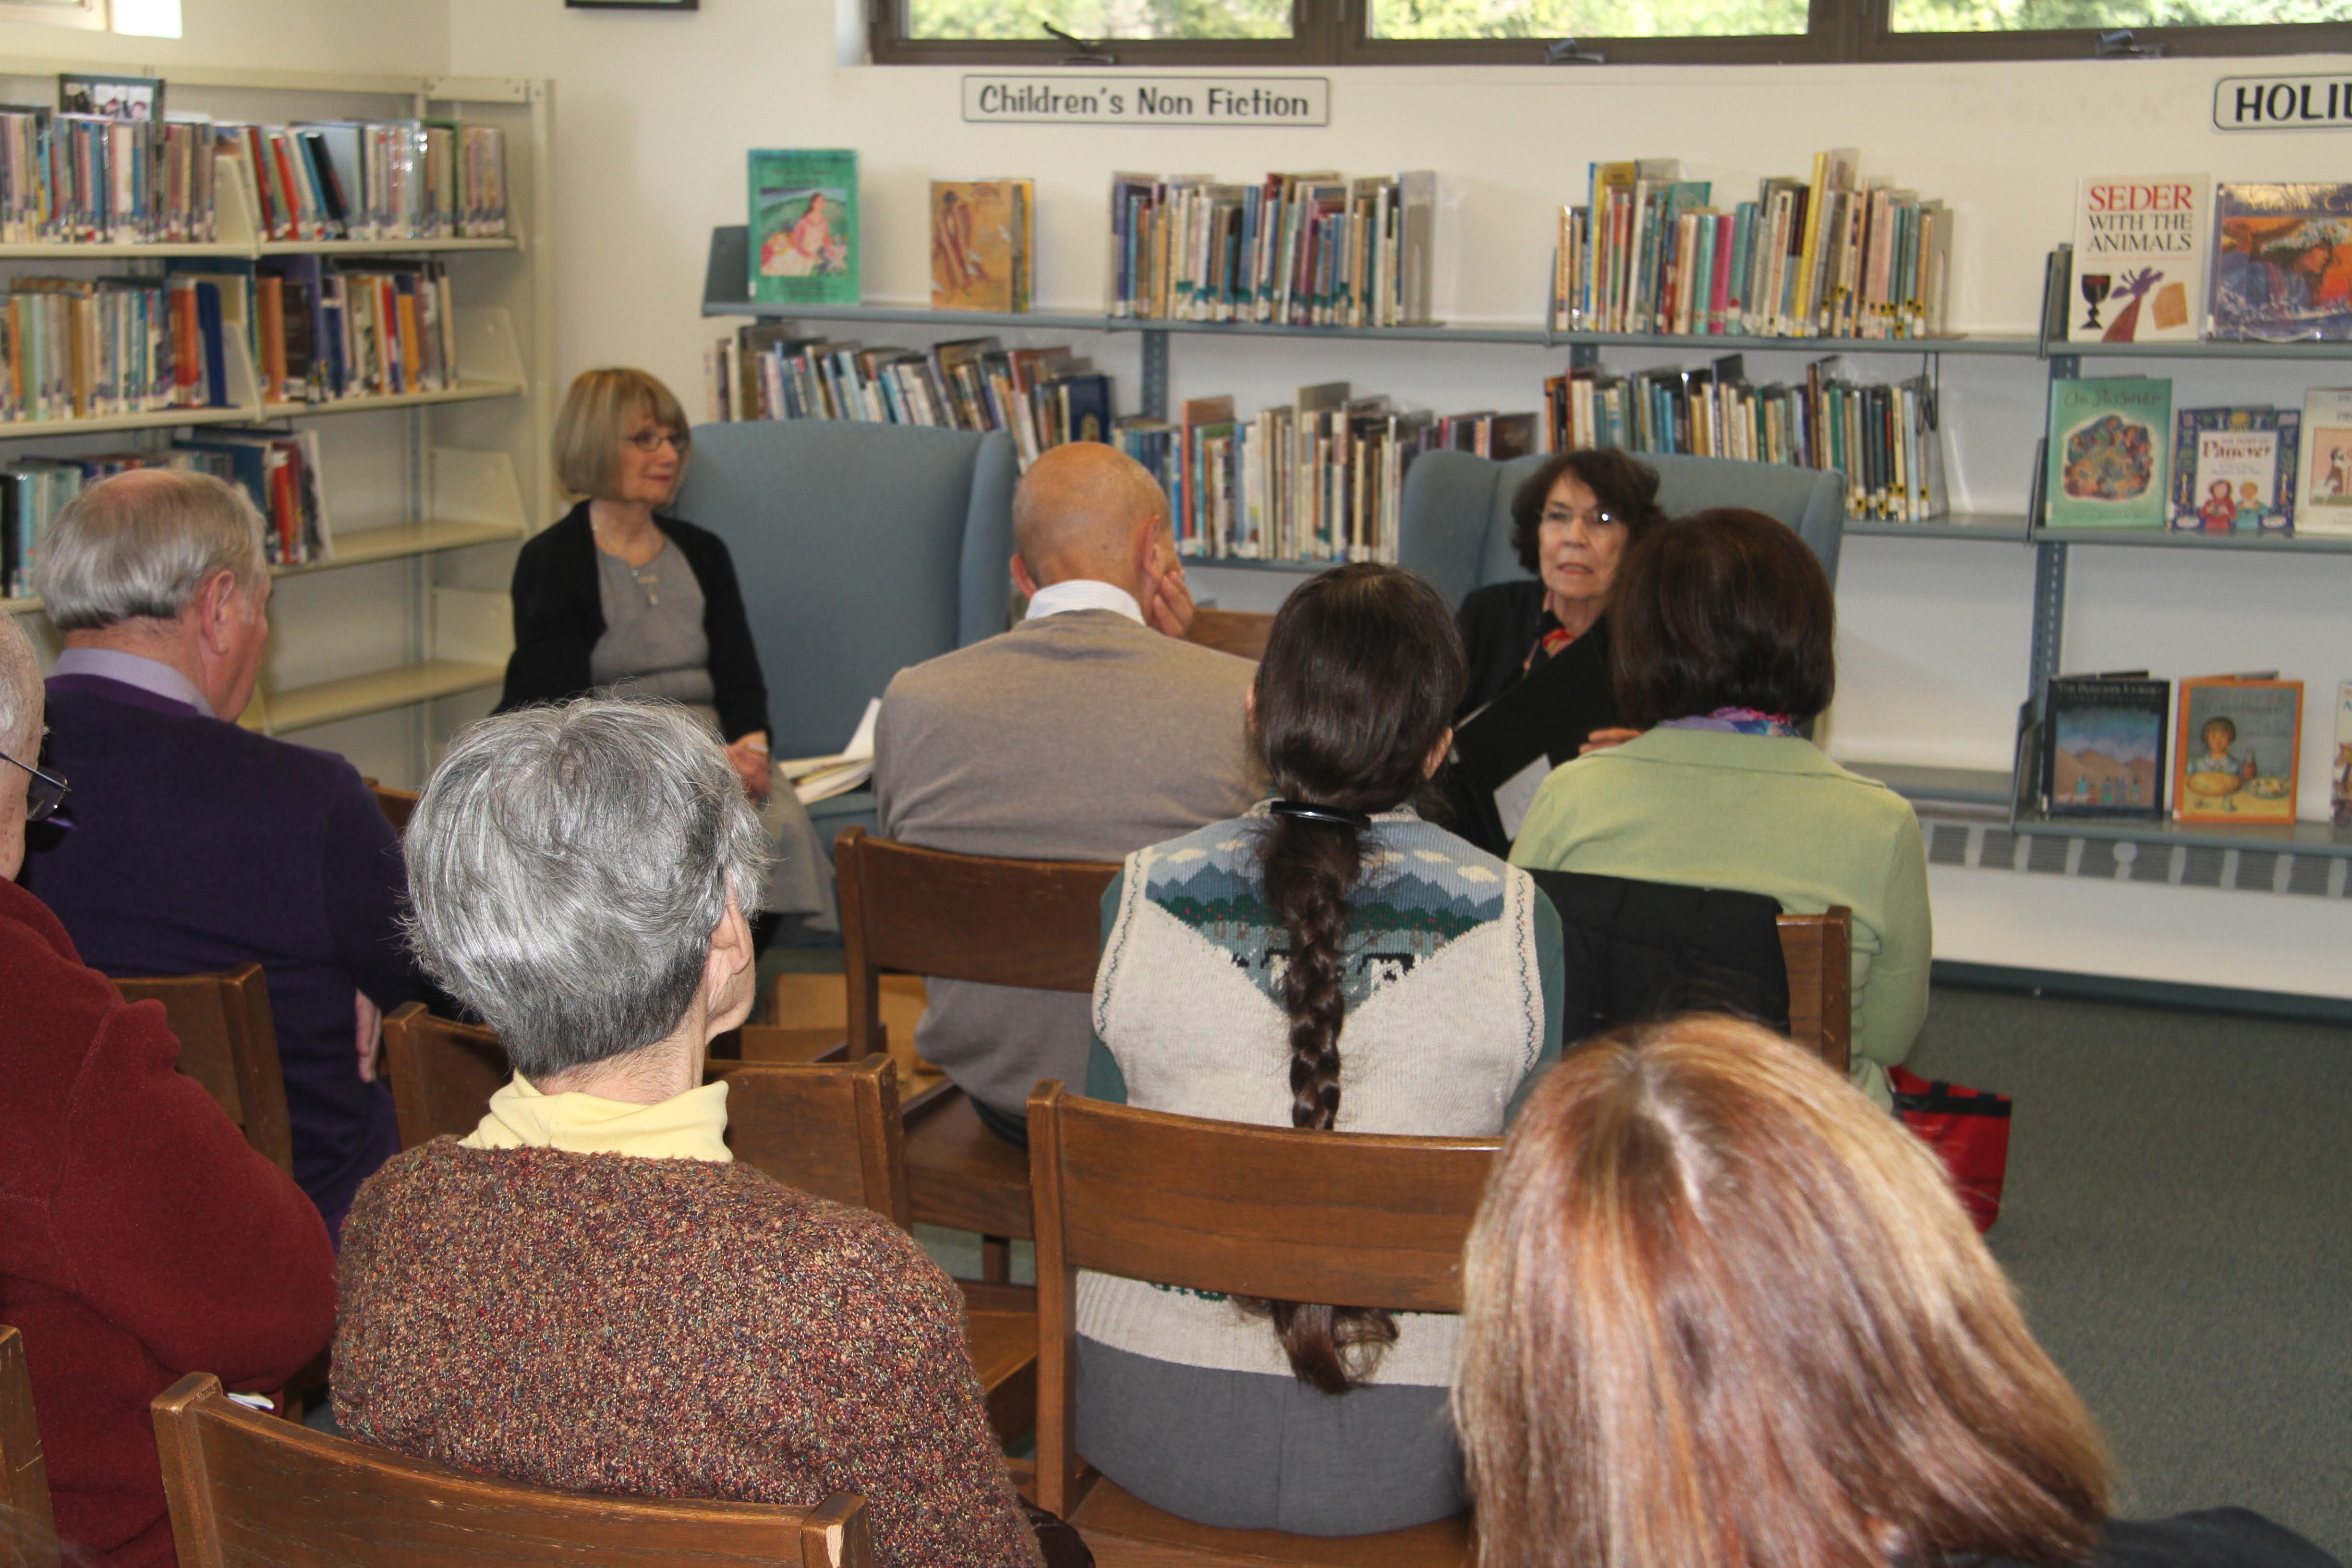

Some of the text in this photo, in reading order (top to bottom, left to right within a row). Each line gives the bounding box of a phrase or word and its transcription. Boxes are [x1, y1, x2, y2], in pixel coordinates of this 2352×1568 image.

[980, 85, 1309, 117] Children's Non Fiction
[2088, 184, 2194, 211] SEDER
[2088, 213, 2193, 231] WITH THE
[2087, 232, 2192, 253] ANIMALS
